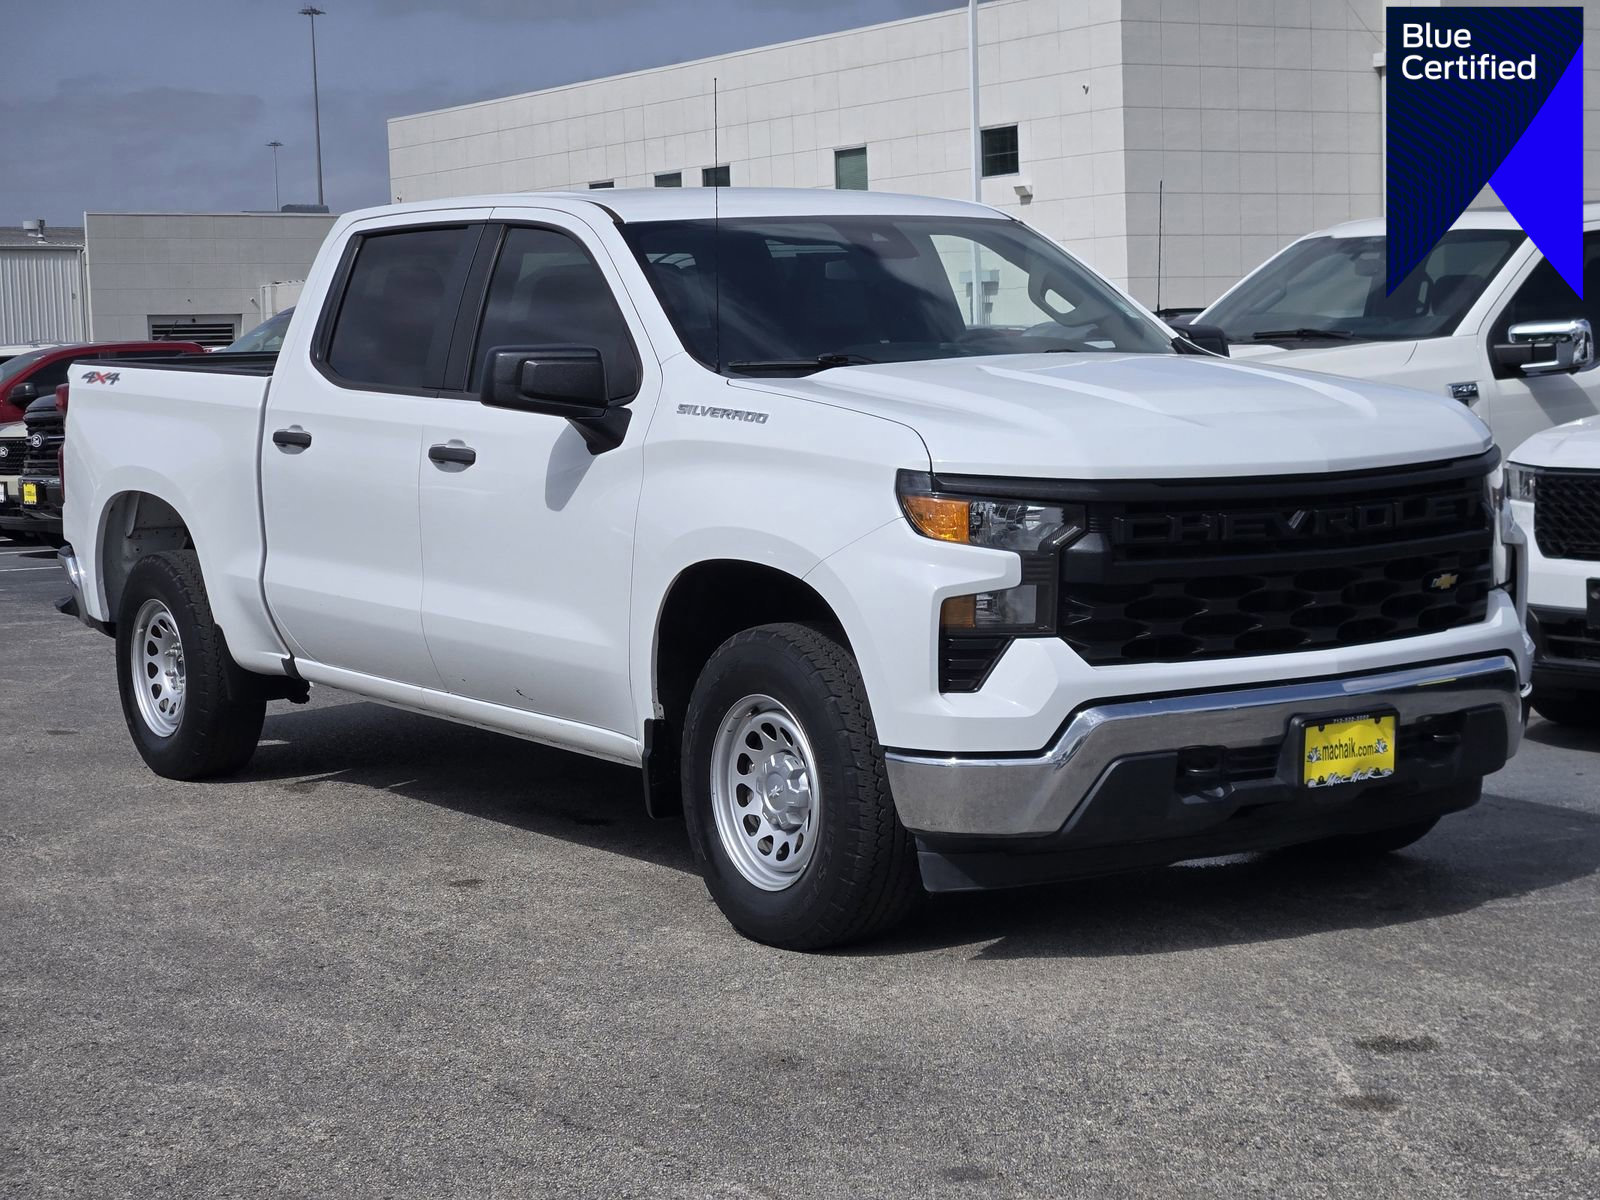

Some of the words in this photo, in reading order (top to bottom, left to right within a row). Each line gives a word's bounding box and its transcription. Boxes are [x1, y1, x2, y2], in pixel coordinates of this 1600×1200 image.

[676, 403, 770, 425] SILVERADO
[1111, 490, 1482, 545] CHEVROLET
[1321, 737, 1375, 761] machaik.com
